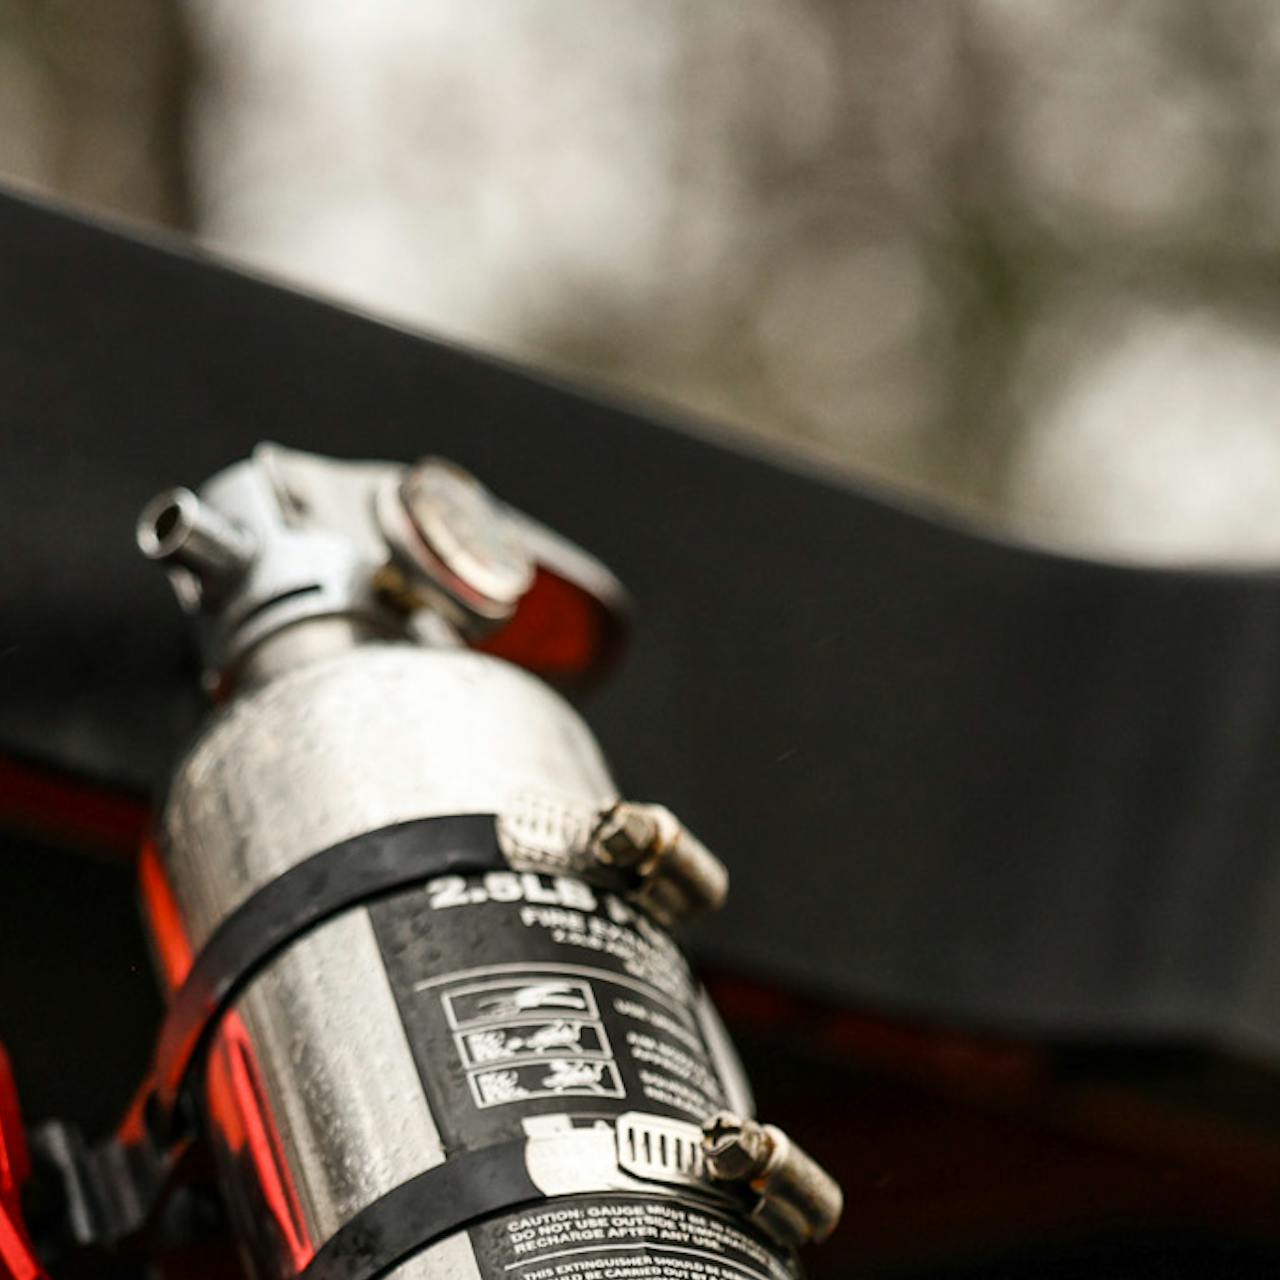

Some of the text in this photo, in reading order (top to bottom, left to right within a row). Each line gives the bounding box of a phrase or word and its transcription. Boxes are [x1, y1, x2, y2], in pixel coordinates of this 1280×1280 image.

[507, 1208, 585, 1232] CAUTION:
[587, 1206, 644, 1217] GAUGE
[645, 1205, 685, 1221] MUST
[687, 1213, 707, 1226] BE
[510, 1229, 536, 1244] DO
[538, 1222, 571, 1236] NOT
[575, 1218, 609, 1230] USE
[611, 1215, 677, 1230] OUTSIDE
[513, 1229, 605, 1254] RECHARGE
[607, 1226, 658, 1239] AFTER
[660, 1229, 690, 1242] ANY
[555, 1255, 653, 1275] EXTINGUISHER
[653, 1255, 705, 1272] SHOULD
[705, 1265, 720, 1276] BE
[584, 1270, 603, 1280] BE
[604, 1266, 661, 1278] CARRIED
[663, 1267, 689, 1279] OUT
